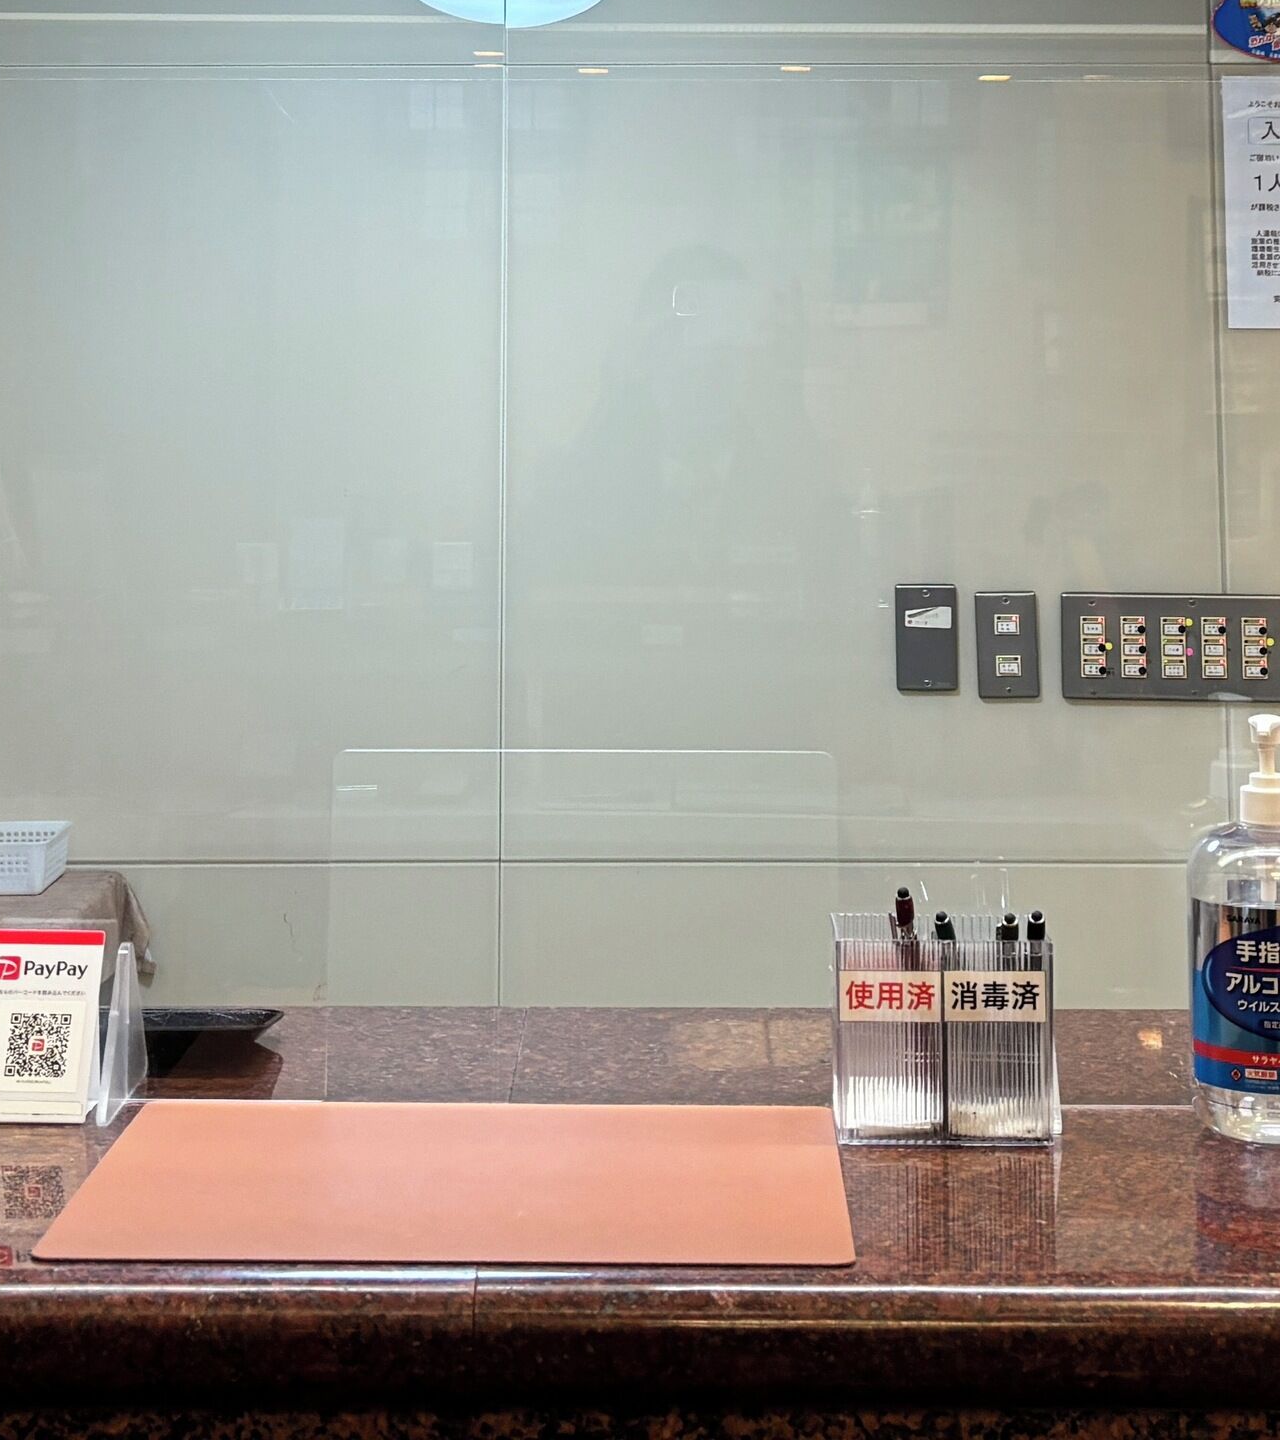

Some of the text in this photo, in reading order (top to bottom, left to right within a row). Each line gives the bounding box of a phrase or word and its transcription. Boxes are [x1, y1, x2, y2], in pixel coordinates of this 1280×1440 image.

[23, 960, 88, 980] PayPay
[845, 980, 936, 1010] 使用済
[951, 980, 1041, 1011] 消毒済
